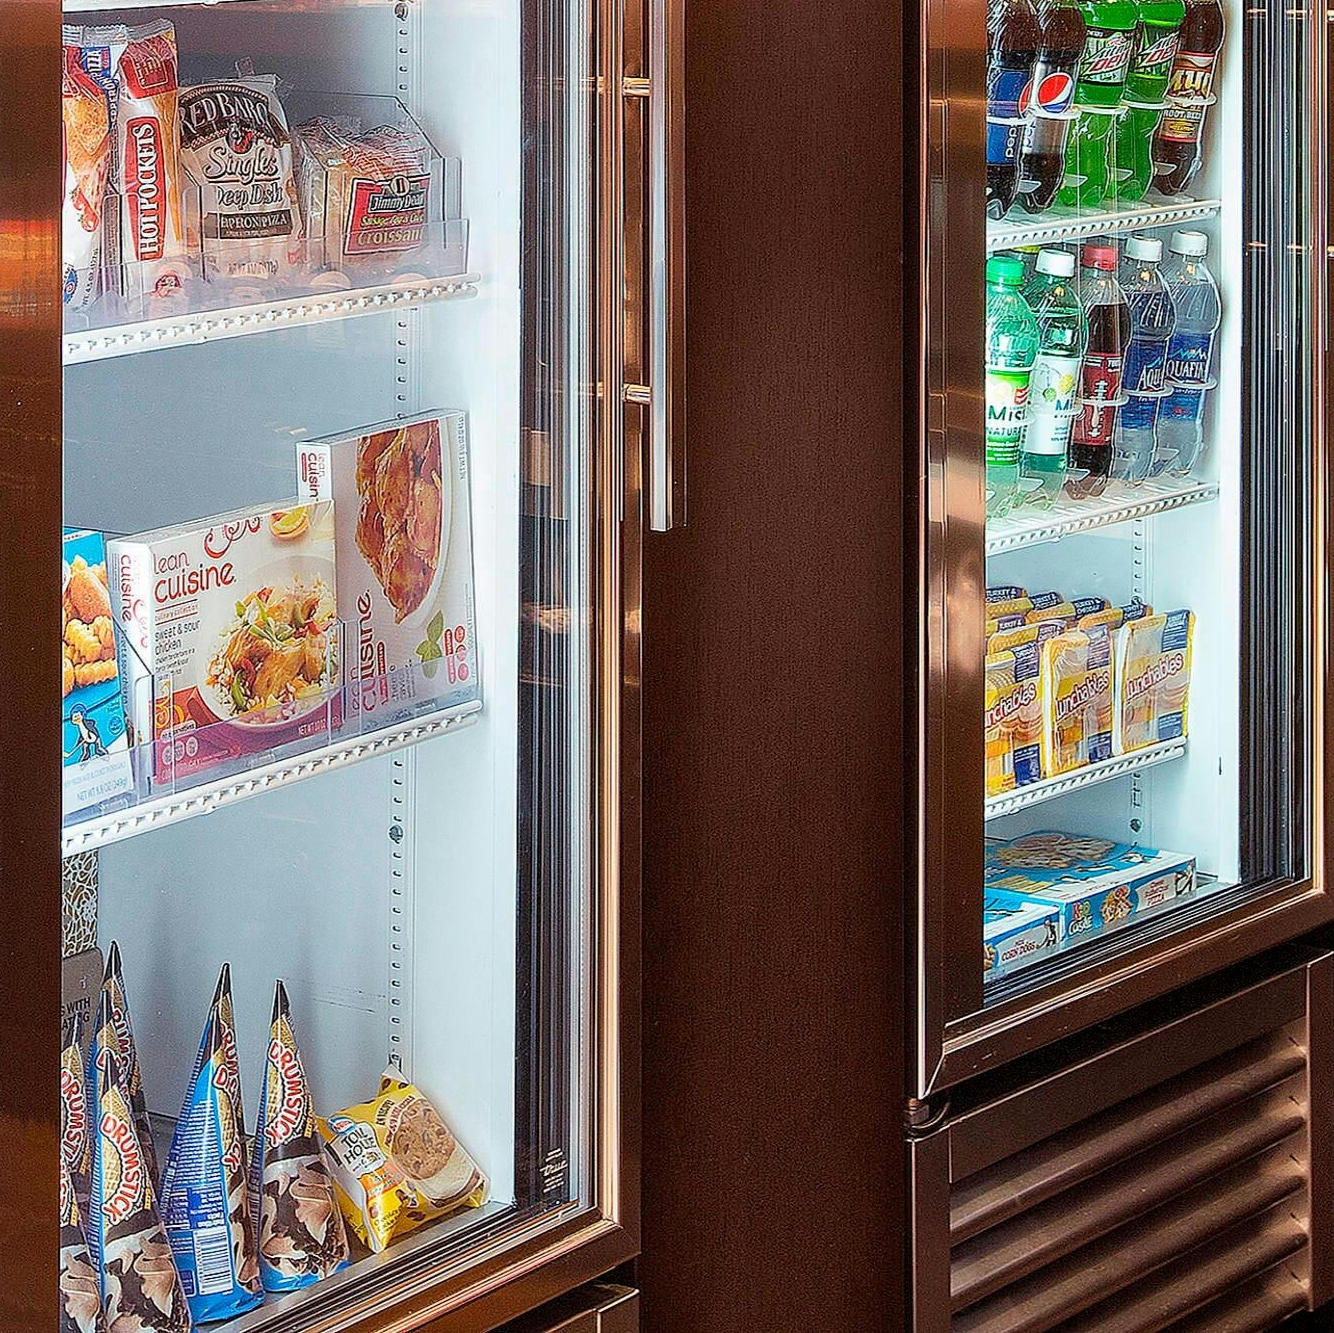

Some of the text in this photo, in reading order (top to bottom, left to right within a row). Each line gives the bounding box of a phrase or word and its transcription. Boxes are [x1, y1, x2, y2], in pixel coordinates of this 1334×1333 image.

[177, 96, 217, 136] RED
[203, 145, 279, 185] Singles
[136, 124, 159, 254] HOT POCKETS
[371, 195, 405, 211] Jimmy
[153, 551, 191, 575] lean
[154, 562, 238, 604] cuisine
[120, 554, 134, 623] cuisine
[155, 626, 177, 642] sweet
[183, 620, 201, 634] sour
[155, 639, 183, 656] chicken
[1056, 669, 1110, 718] Lunchables
[1126, 652, 1184, 700] Lunchables
[264, 1039, 304, 1147] DRUMSTICK
[101, 1115, 142, 1223] DRUMSTICK
